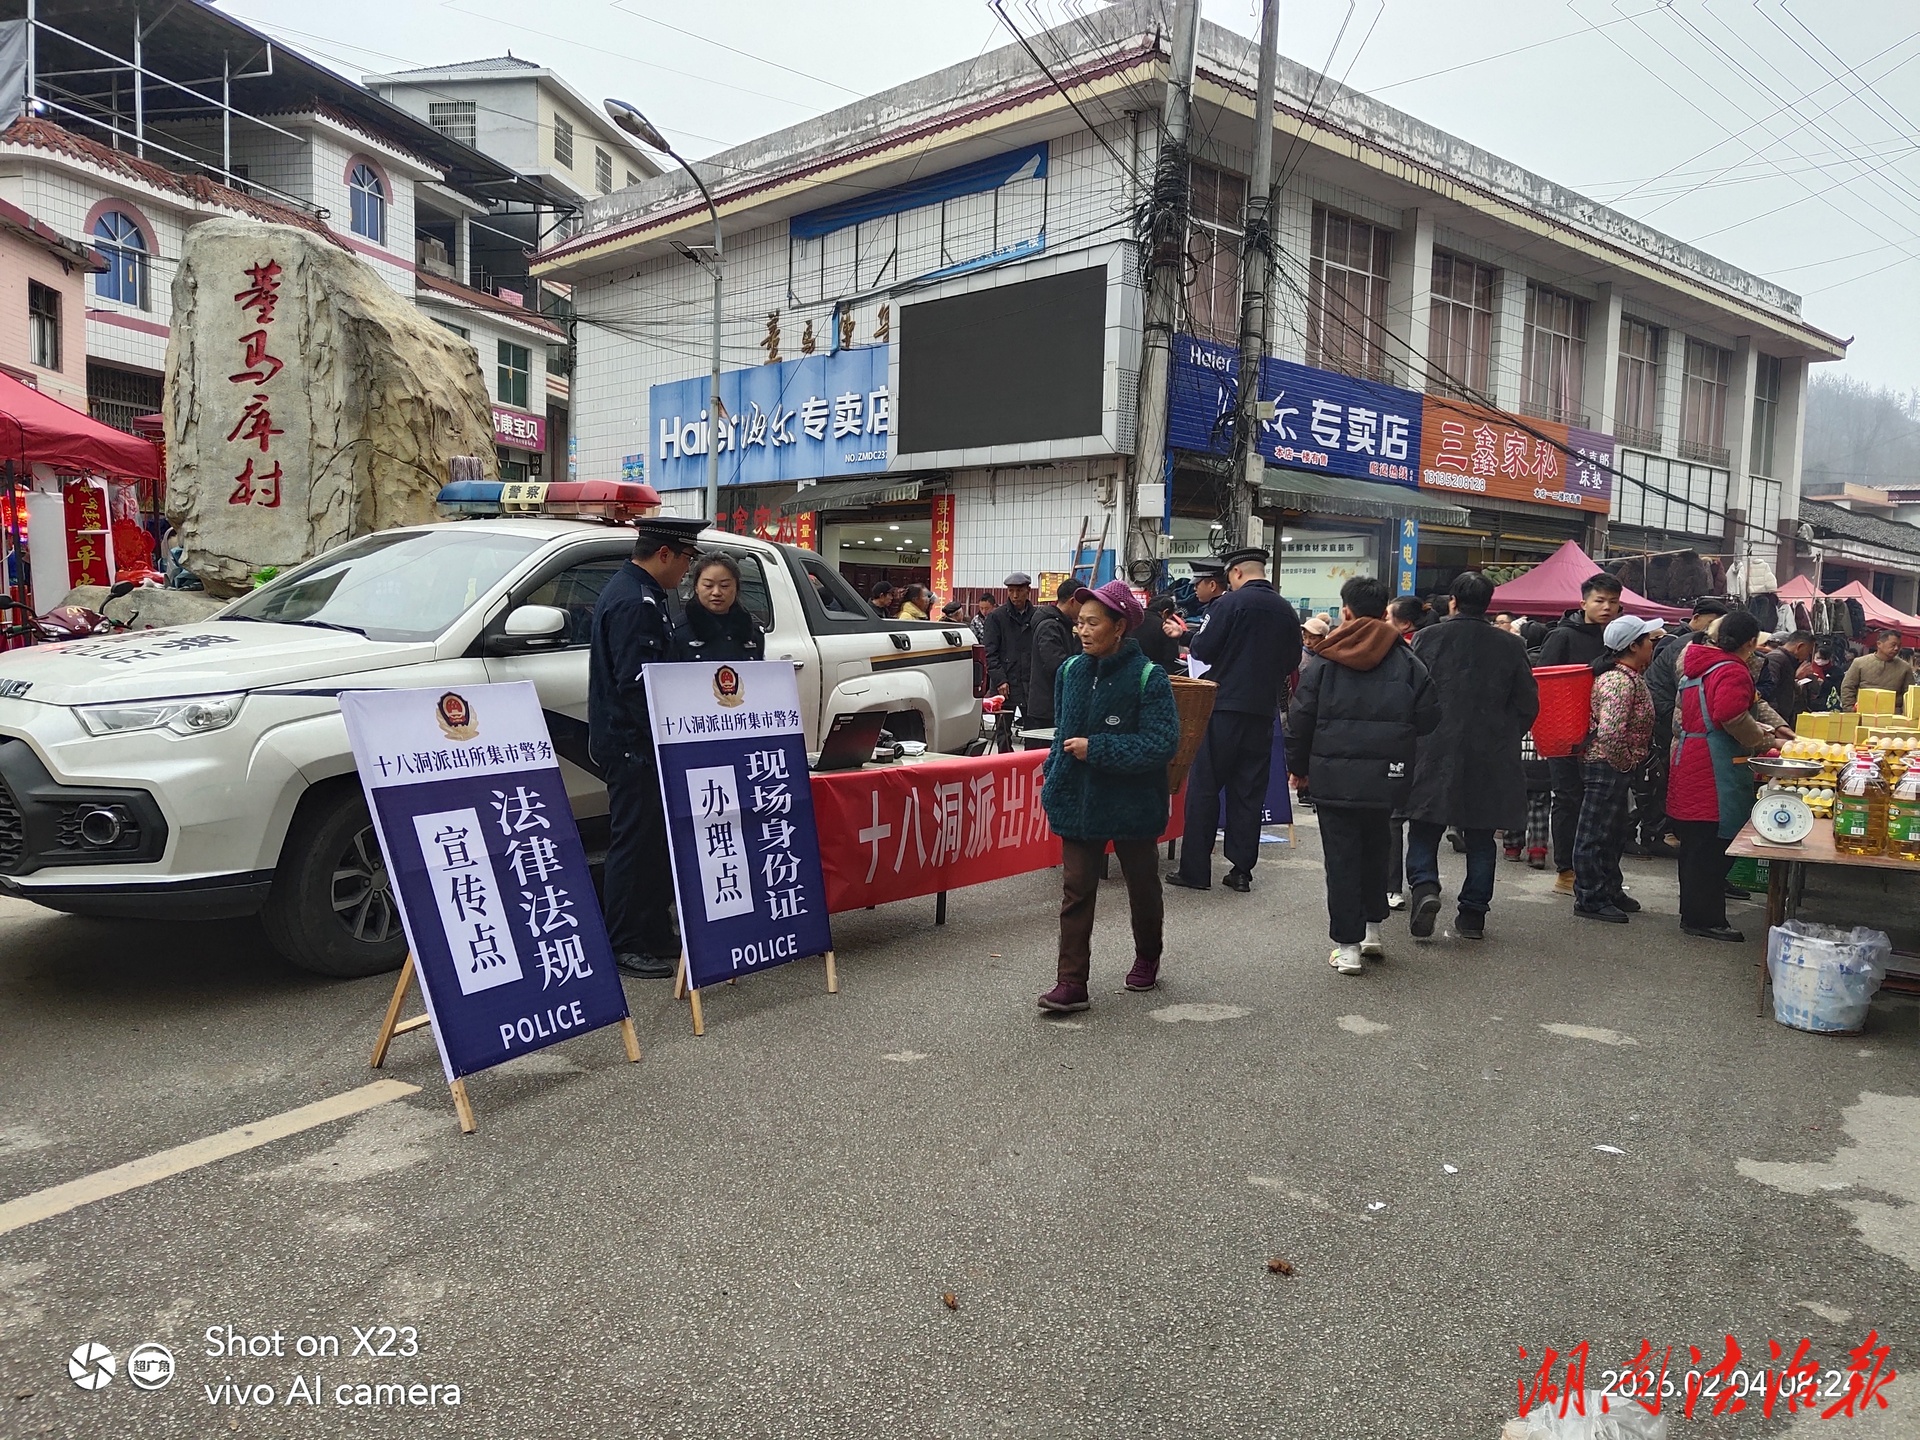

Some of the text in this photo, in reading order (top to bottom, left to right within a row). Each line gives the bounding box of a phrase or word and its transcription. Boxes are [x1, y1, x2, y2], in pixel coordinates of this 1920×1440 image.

[1190, 344, 1231, 372] Haier
[227, 258, 285, 508] 董马库村
[660, 409, 739, 460] Haier
[1274, 445, 1329, 467] 本店一楼有售
[1436, 421, 1558, 483] 三鑫家私
[508, 485, 541, 499] 警察
[1423, 469, 1486, 492] 13135208128
[1578, 470, 1603, 489] 床垫
[661, 709, 799, 736] 十八洞派出所集市警务
[373, 740, 552, 778] 十八洞派出所集市警务
[702, 779, 743, 905] 办理点
[744, 748, 809, 921] 现场身份证
[434, 826, 507, 974] 宣传点
[490, 786, 593, 992] 法律法规
[730, 933, 798, 970] POLICE
[499, 1000, 586, 1050] POLICE
